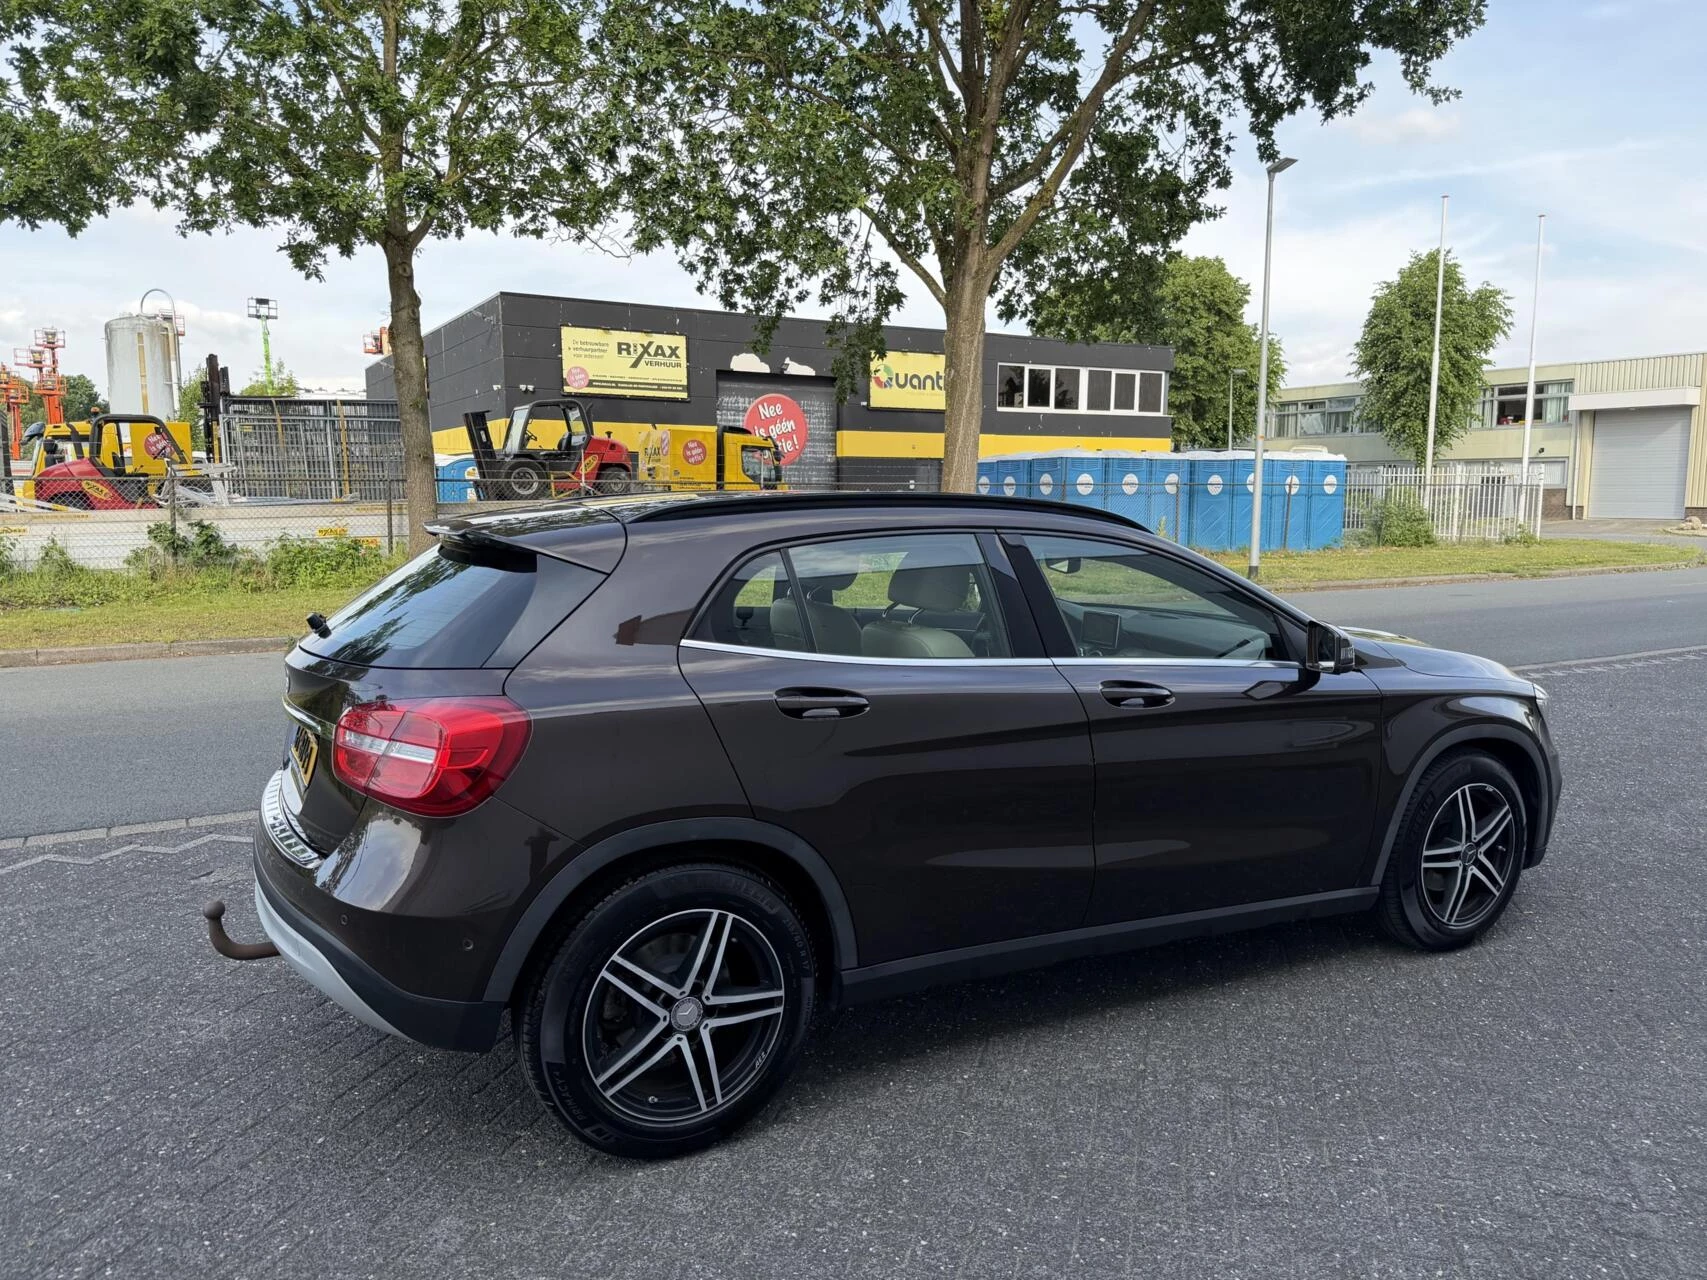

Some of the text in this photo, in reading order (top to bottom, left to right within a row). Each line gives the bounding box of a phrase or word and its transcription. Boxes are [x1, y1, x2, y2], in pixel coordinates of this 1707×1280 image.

[644, 360, 682, 368] VERHUUR
[758, 402, 783, 419] Nee
[754, 418, 796, 439] is géén
